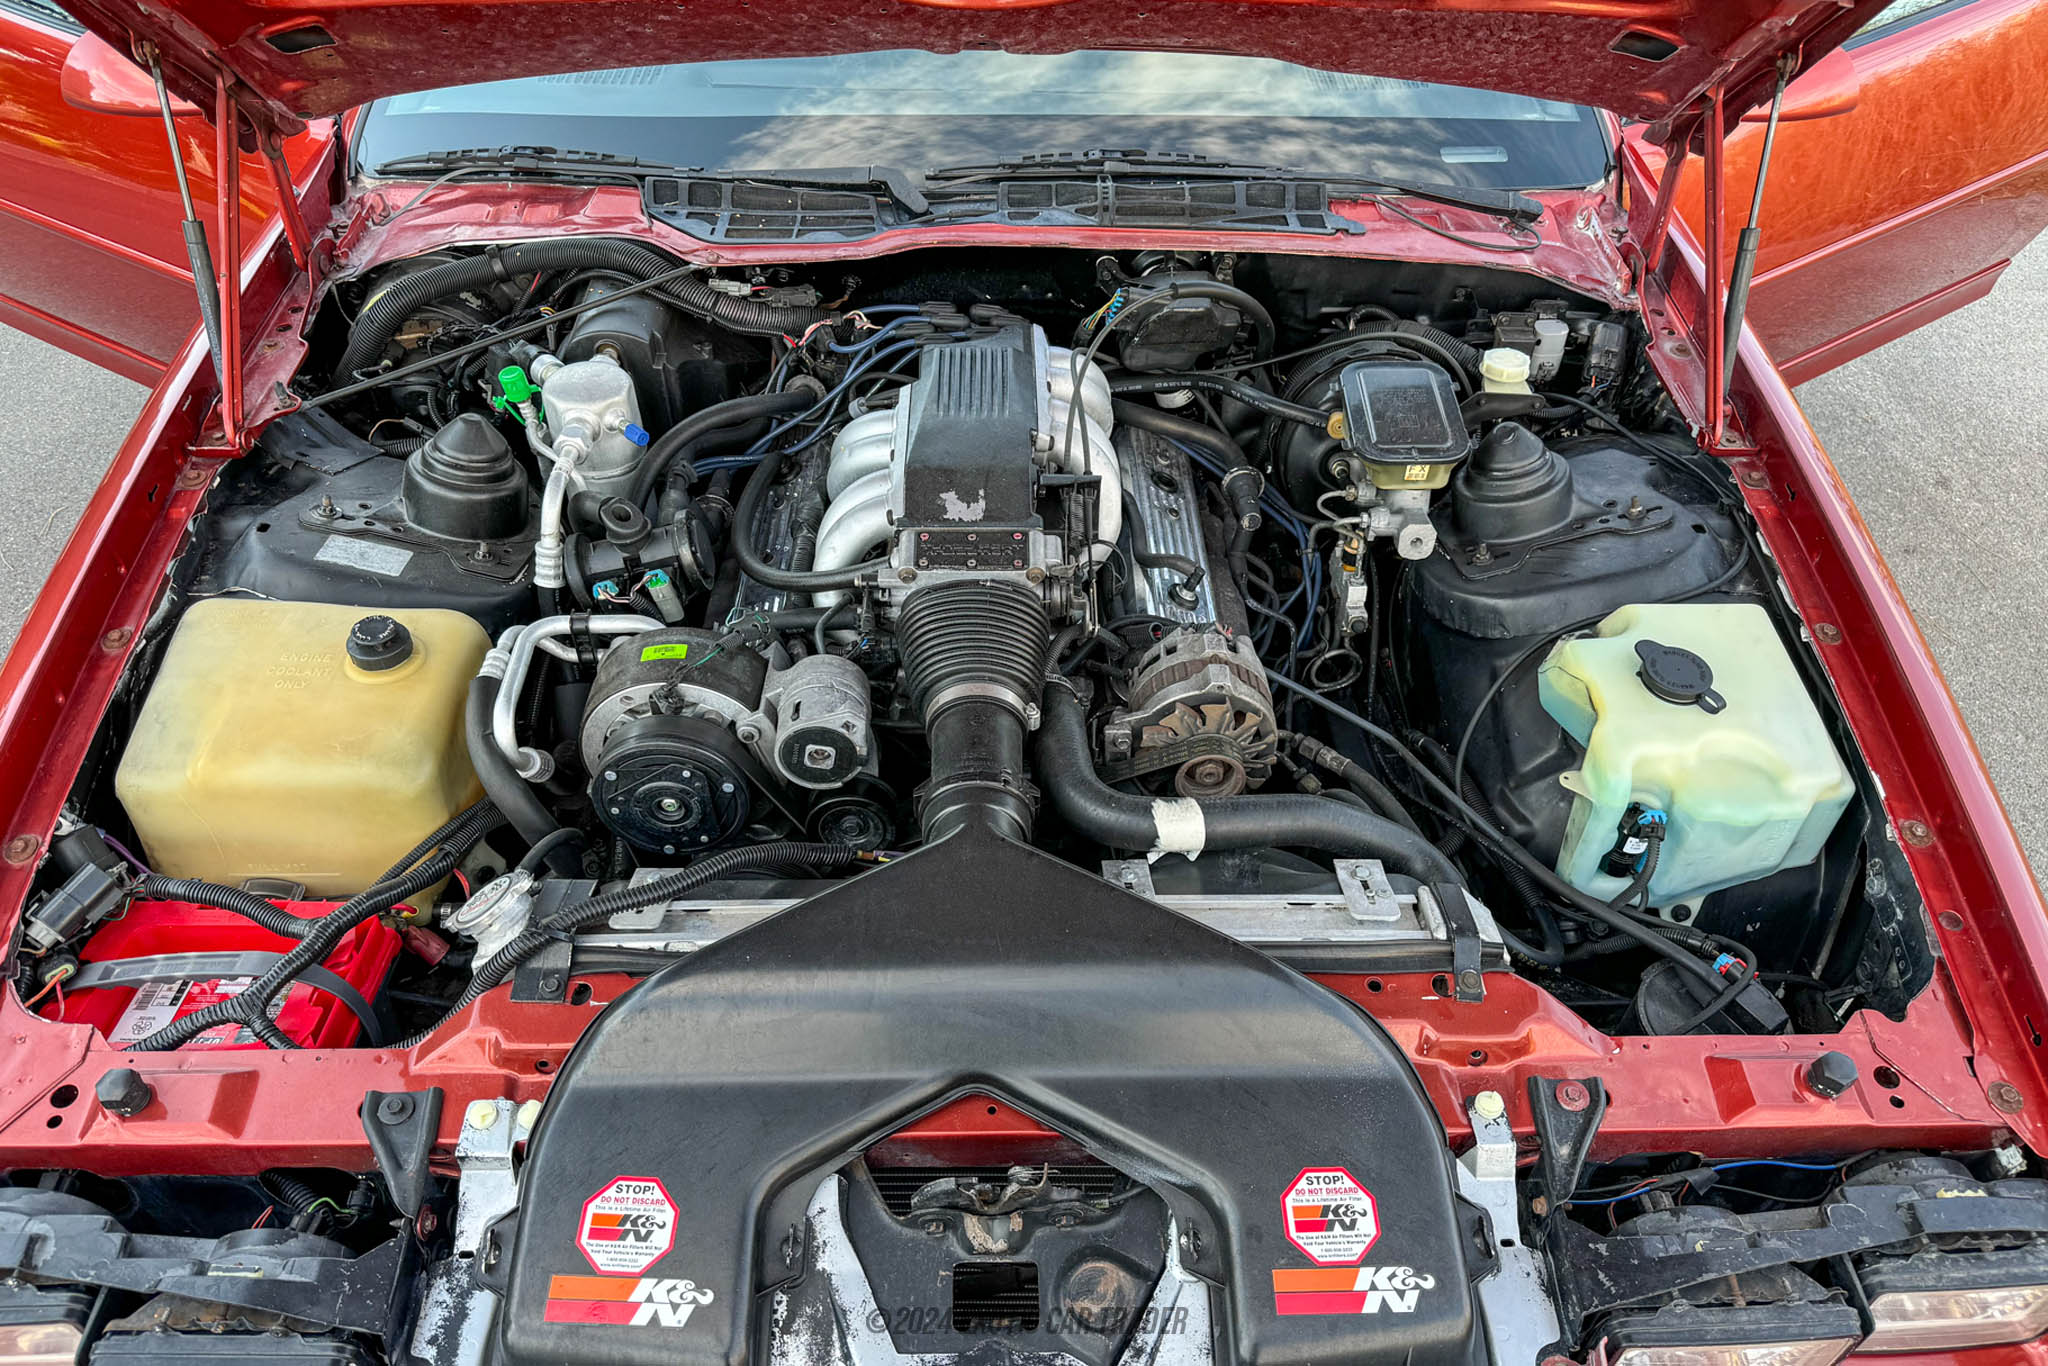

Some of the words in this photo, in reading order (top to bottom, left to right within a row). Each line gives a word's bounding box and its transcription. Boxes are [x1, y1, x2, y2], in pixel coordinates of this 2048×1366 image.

[280, 654, 332, 662] ENGINE
[266, 666, 332, 677] COOLANT
[274, 680, 307, 689] ONLY
[1305, 1175, 1345, 1186] STOP!
[615, 1184, 655, 1196] STOP!
[1295, 1188, 1306, 1196] DO
[1325, 1186, 1359, 1194] DISCARD
[600, 1196, 612, 1204] DO
[614, 1196, 630, 1204] NOT
[632, 1197, 666, 1206] DISCARD
